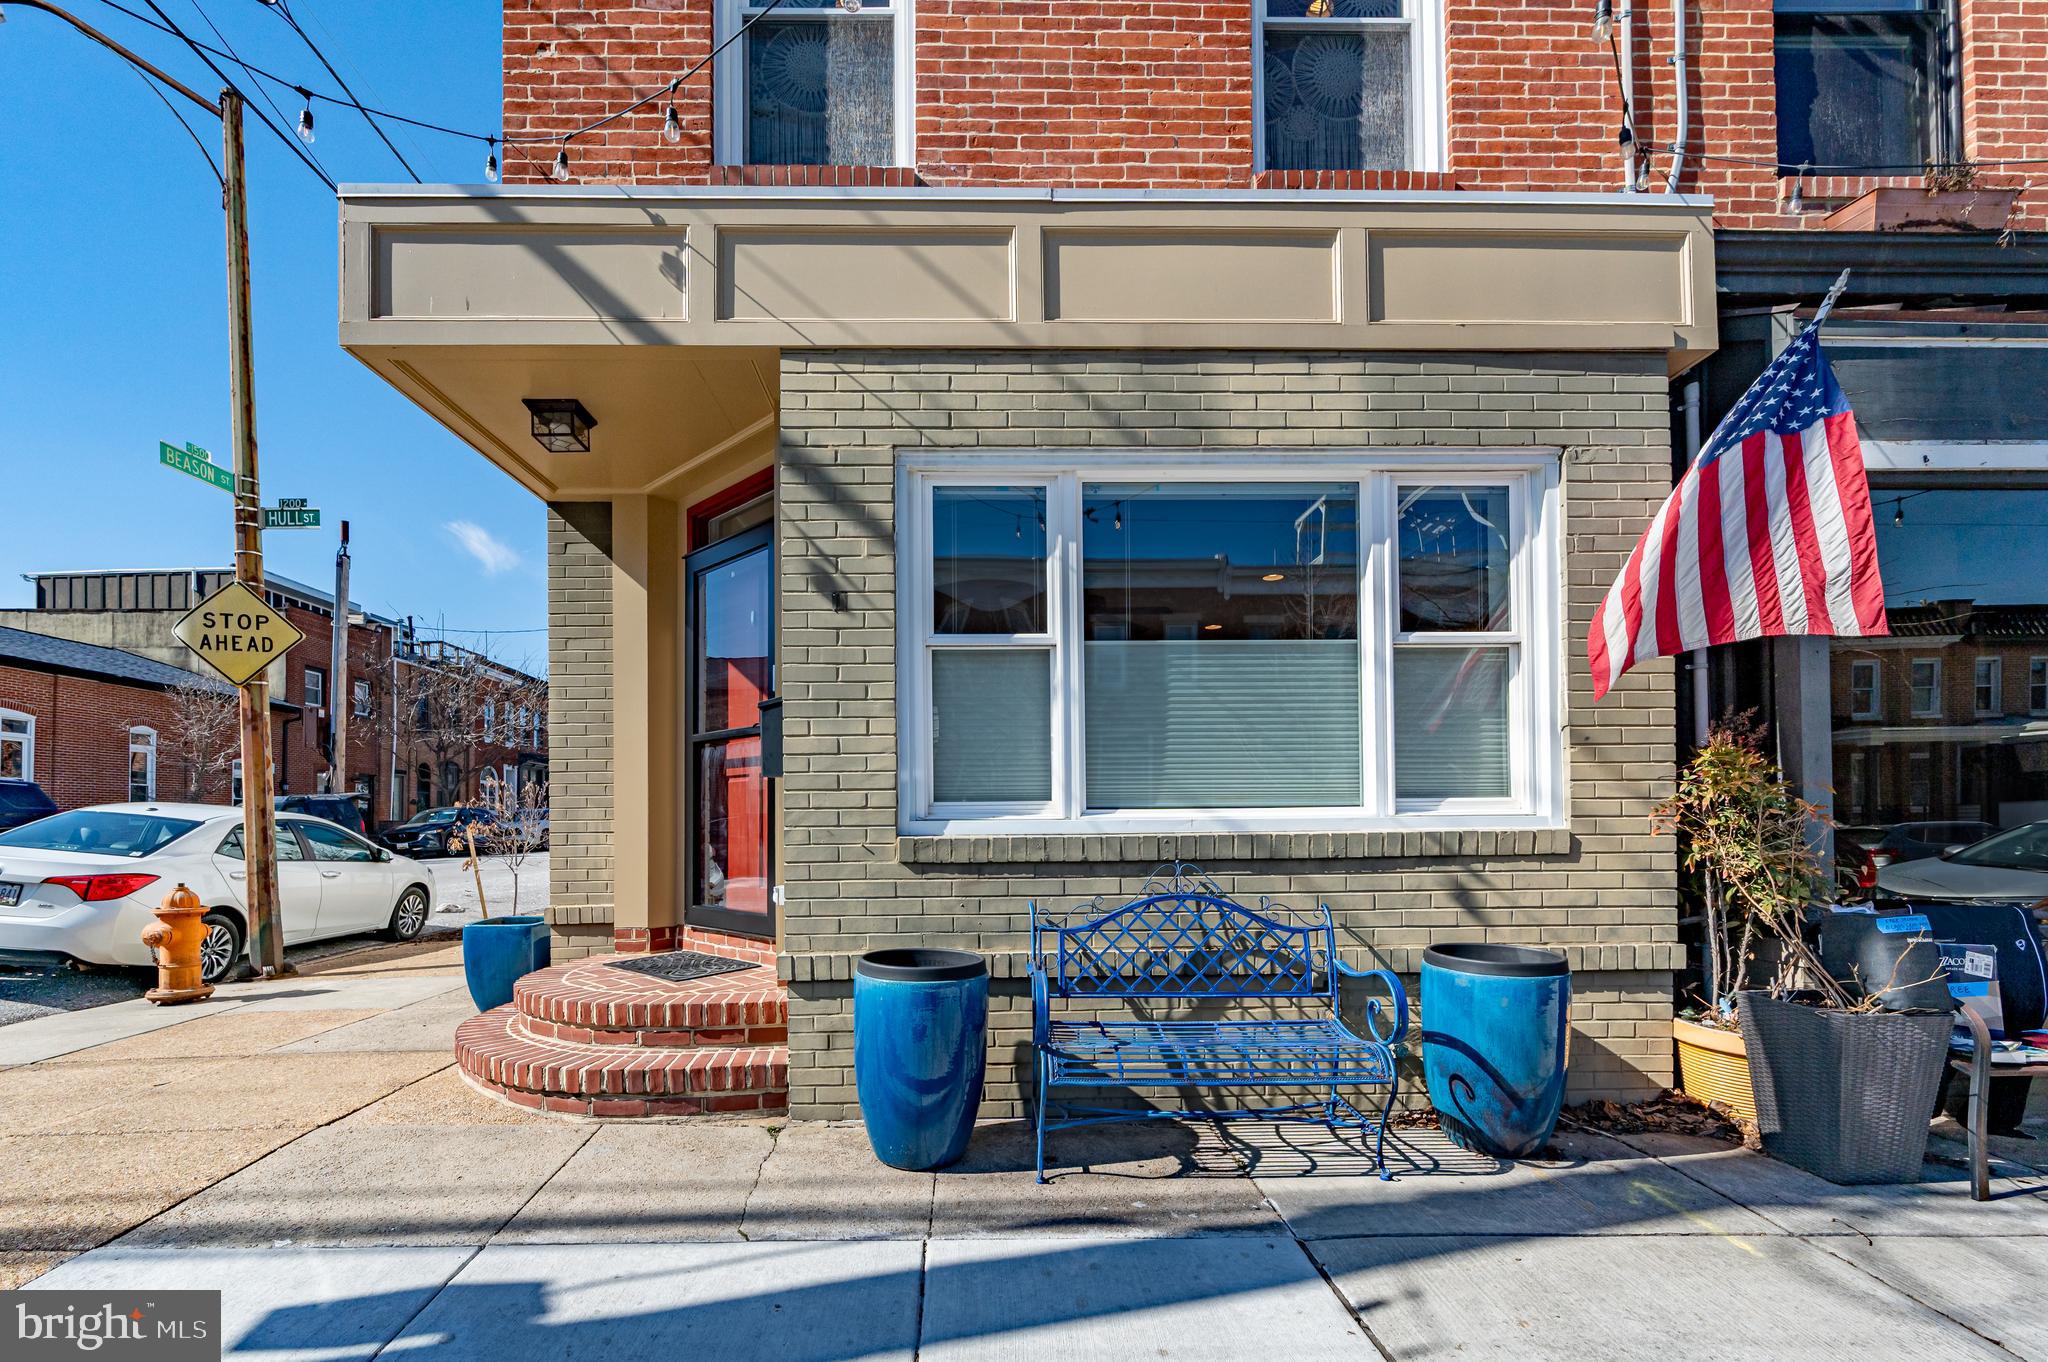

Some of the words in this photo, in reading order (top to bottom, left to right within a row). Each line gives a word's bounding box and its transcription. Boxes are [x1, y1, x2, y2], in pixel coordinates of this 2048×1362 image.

[190, 443, 209, 460] 1500
[166, 447, 215, 482] BEASON
[279, 499, 302, 509] 1200
[269, 511, 303, 526] HULL
[202, 611, 270, 631] STOP
[199, 633, 274, 653] AHEAD
[1950, 985, 1970, 995] REE
